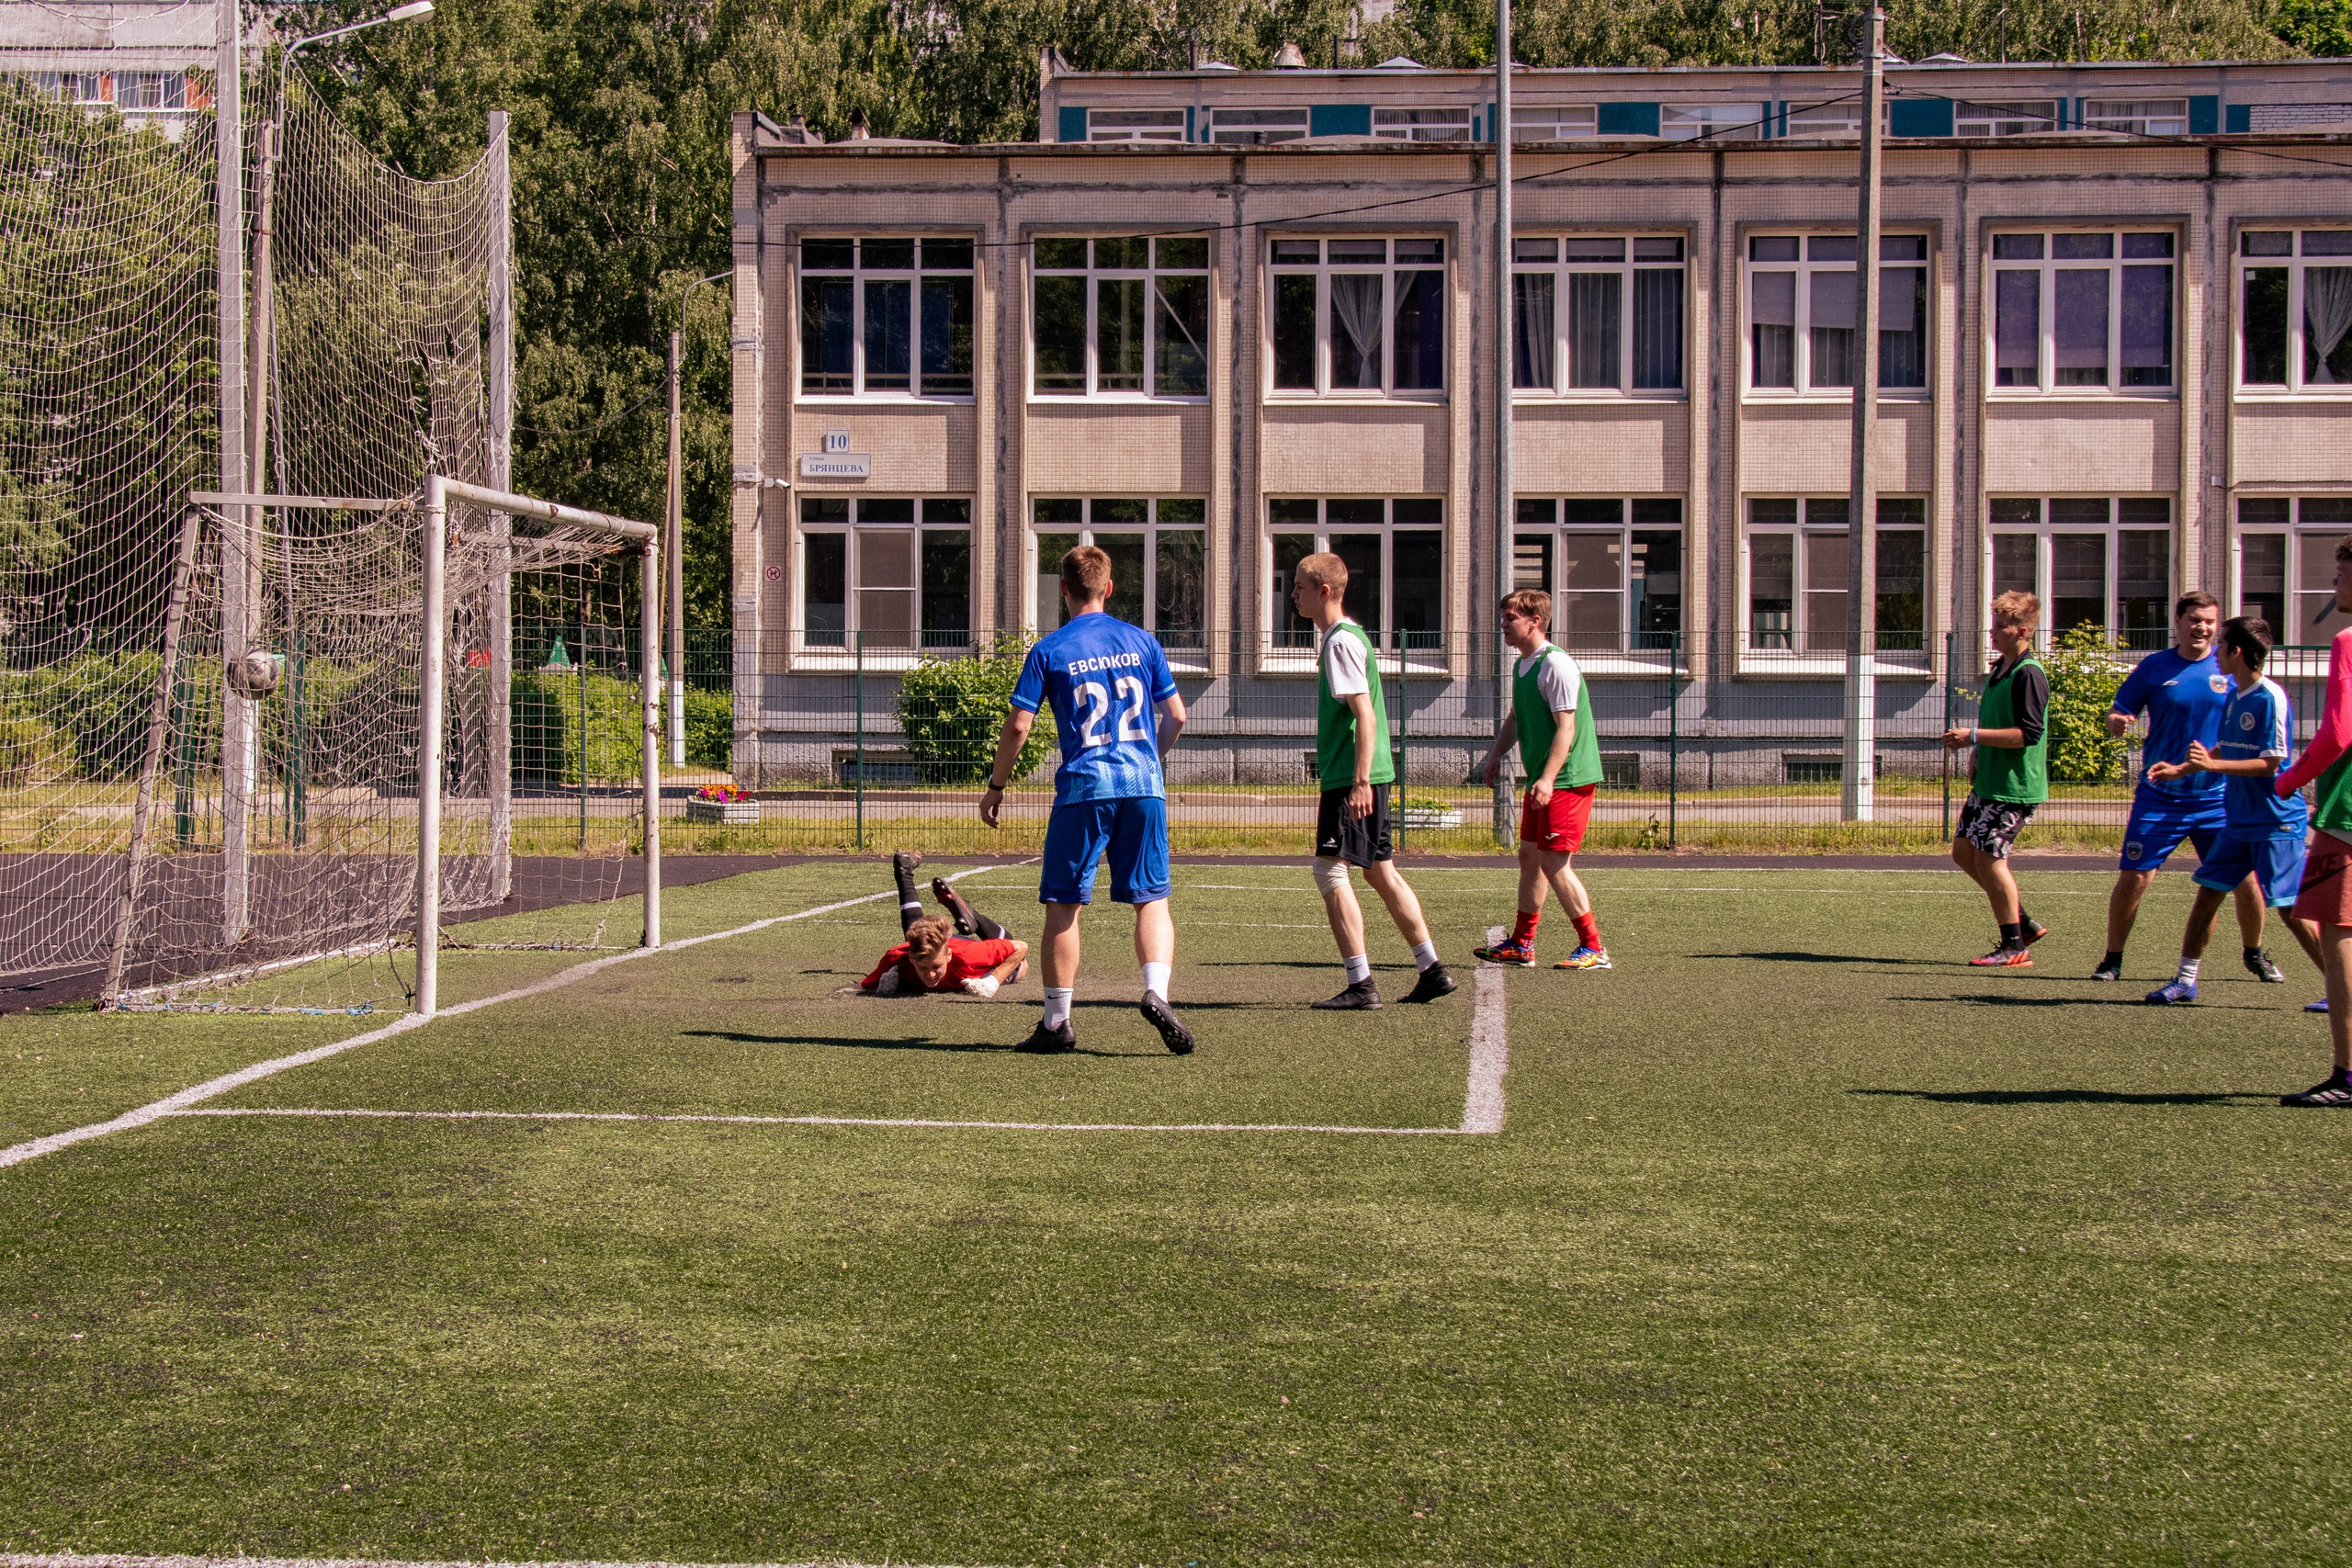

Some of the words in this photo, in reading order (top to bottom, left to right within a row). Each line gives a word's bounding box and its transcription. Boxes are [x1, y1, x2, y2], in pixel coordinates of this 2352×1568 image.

[830, 434, 847, 449] 10
[809, 464, 864, 473] БРЯНЦЕВА
[1068, 652, 1141, 676] ЕВСЮКОВ
[1073, 675, 1148, 749] 22
